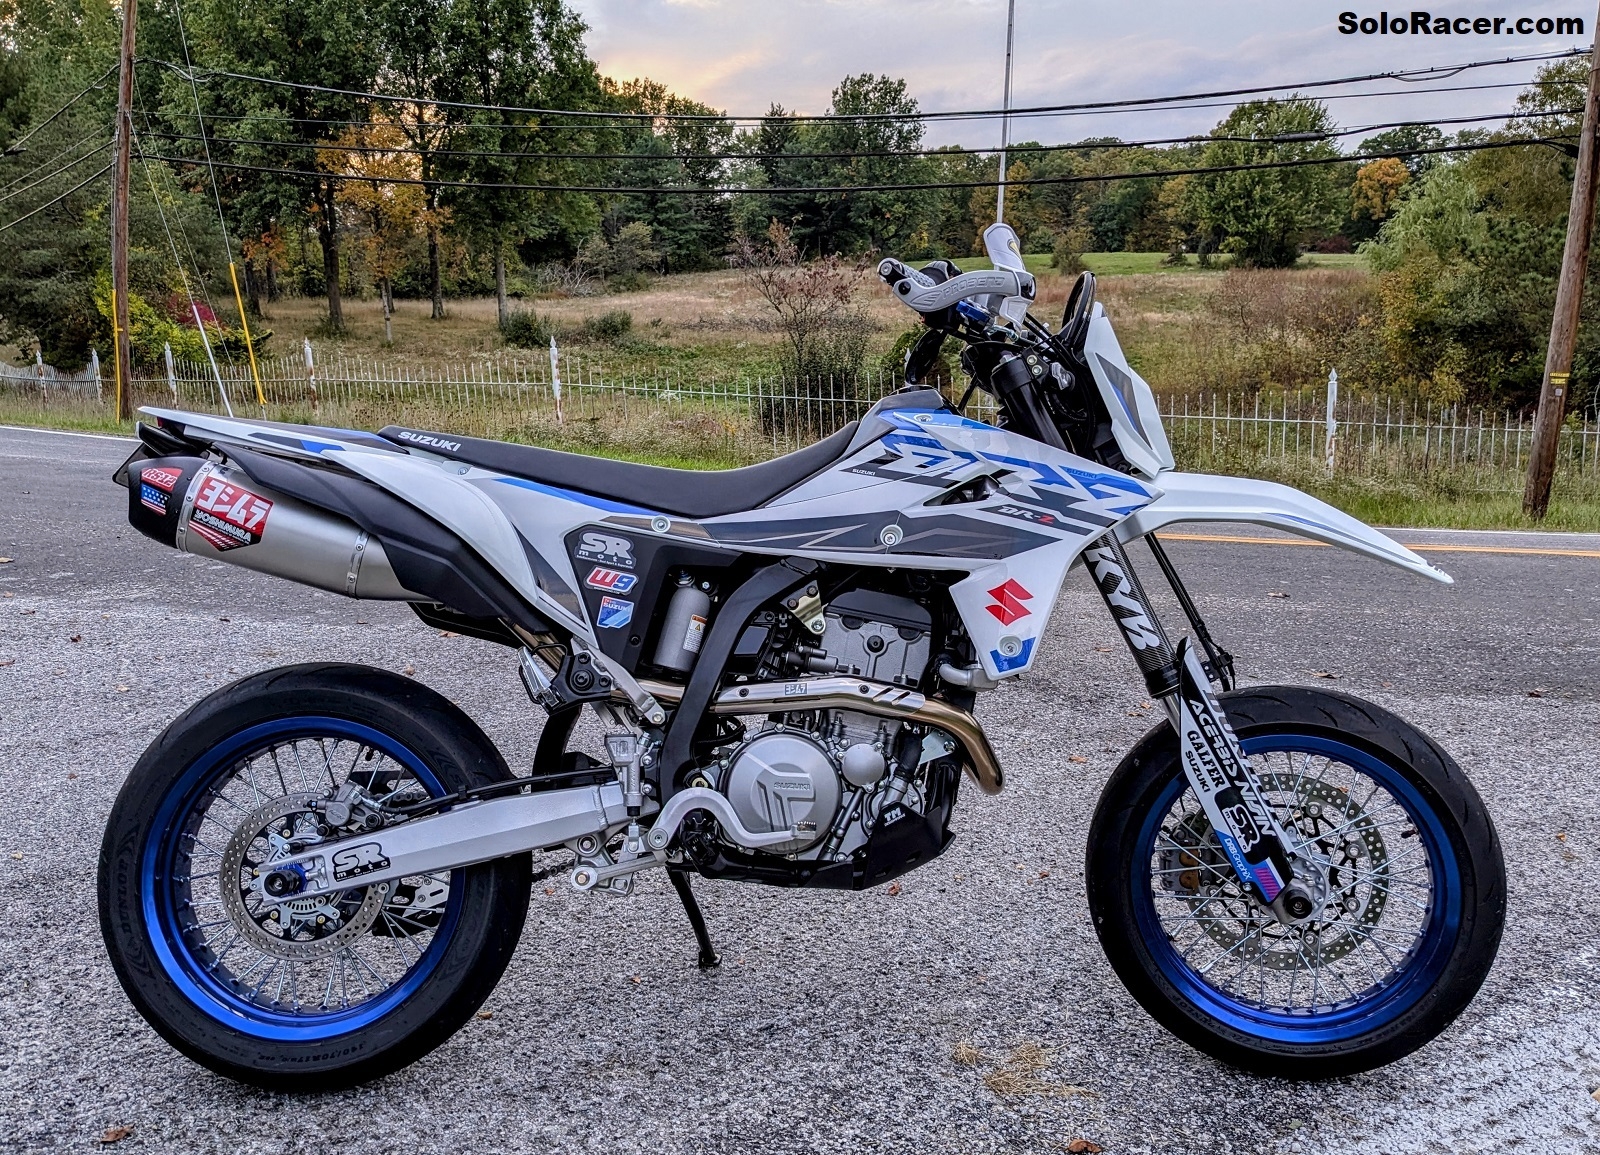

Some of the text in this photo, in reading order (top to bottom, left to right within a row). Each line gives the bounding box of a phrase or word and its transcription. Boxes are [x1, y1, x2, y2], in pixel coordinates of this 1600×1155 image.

[397, 431, 462, 452] SUZUKI
[852, 468, 876, 476] SUZUKI
[1066, 467, 1098, 479] SUZUKI
[197, 479, 271, 529] ヨシムラ
[997, 505, 1056, 525] DR-Z
[194, 509, 252, 543] YOSHIMURA
[578, 549, 633, 565] moto
[580, 532, 632, 559] SR
[1084, 546, 1160, 650] KYB
[1189, 699, 1238, 777] ACERBIS
[1185, 750, 1211, 793] SUZUKI
[1187, 730, 1225, 788] GALFER
[773, 782, 811, 791] SUZUKI
[884, 807, 902, 822] TM
[1229, 804, 1260, 844] SR
[332, 842, 386, 873] SR
